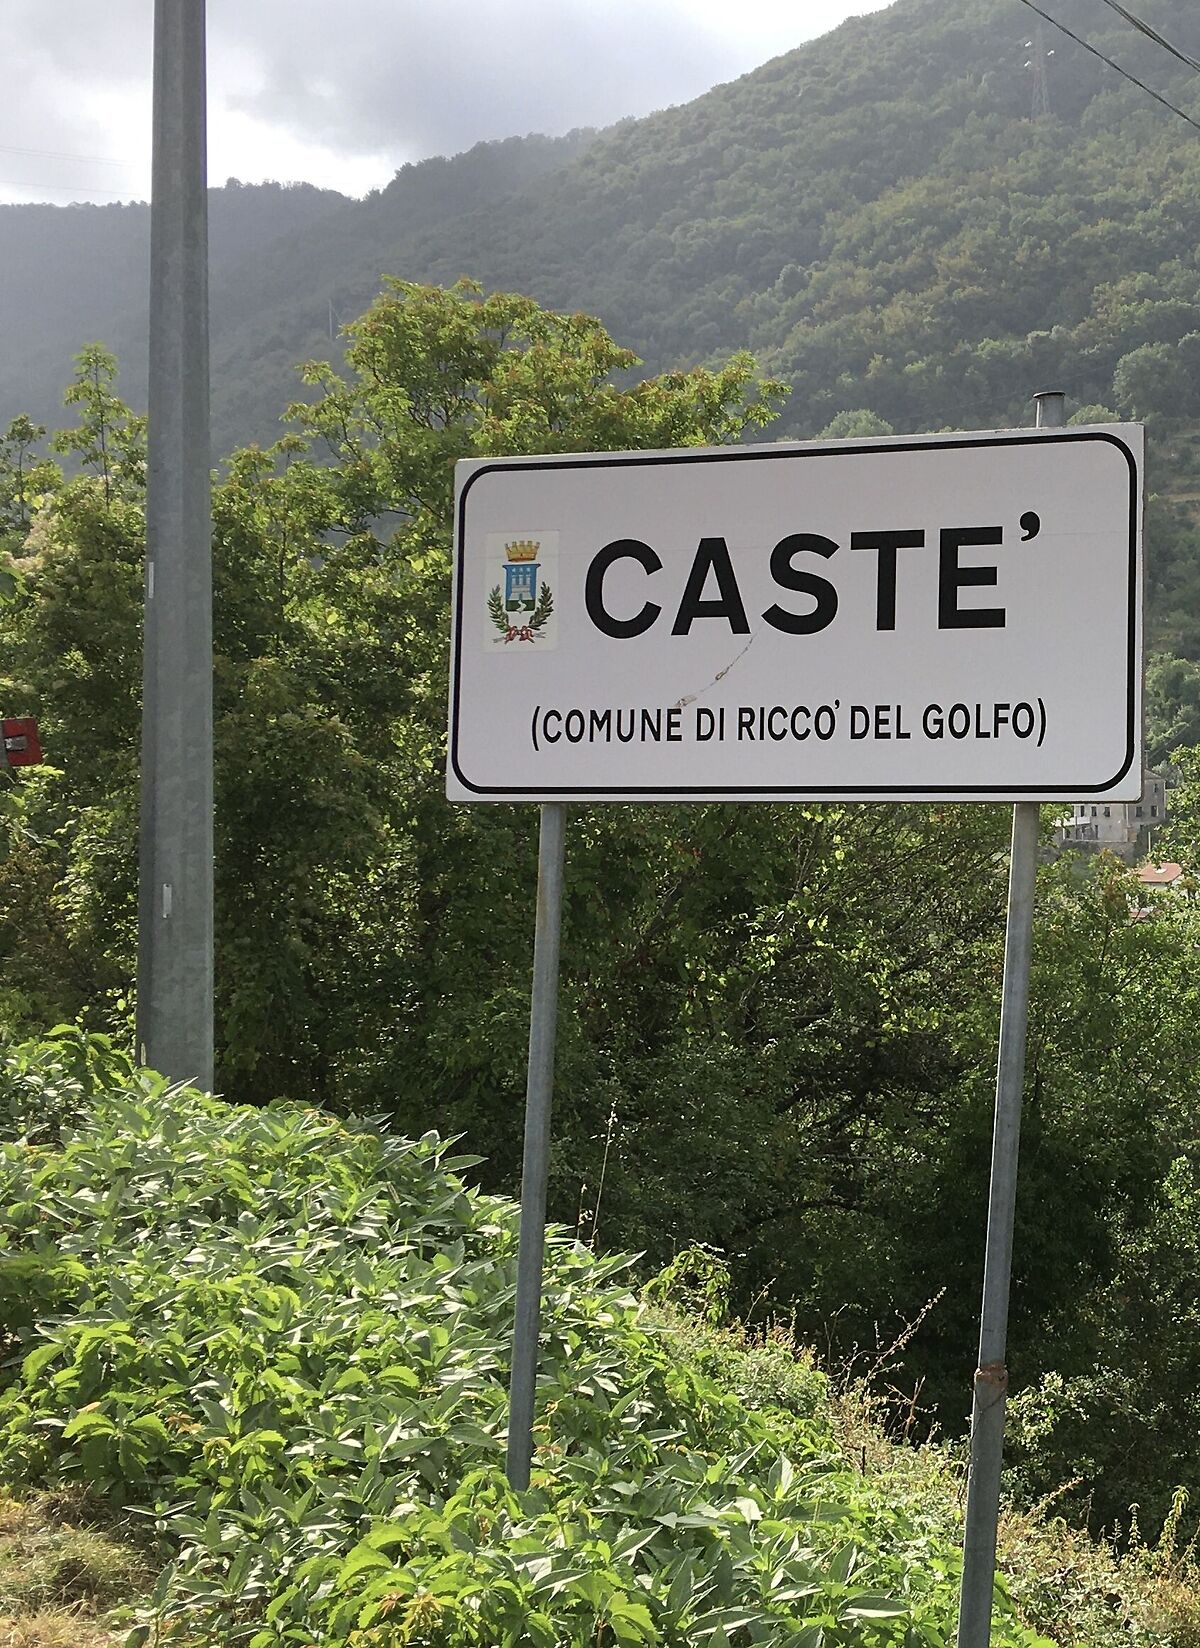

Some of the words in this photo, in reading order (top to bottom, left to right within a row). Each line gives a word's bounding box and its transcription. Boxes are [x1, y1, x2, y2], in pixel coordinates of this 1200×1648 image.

[531, 705, 683, 752] (COMUNE
[696, 707, 725, 742] DI
[849, 704, 911, 740] DEL
[922, 697, 1048, 748] GOLFO)
